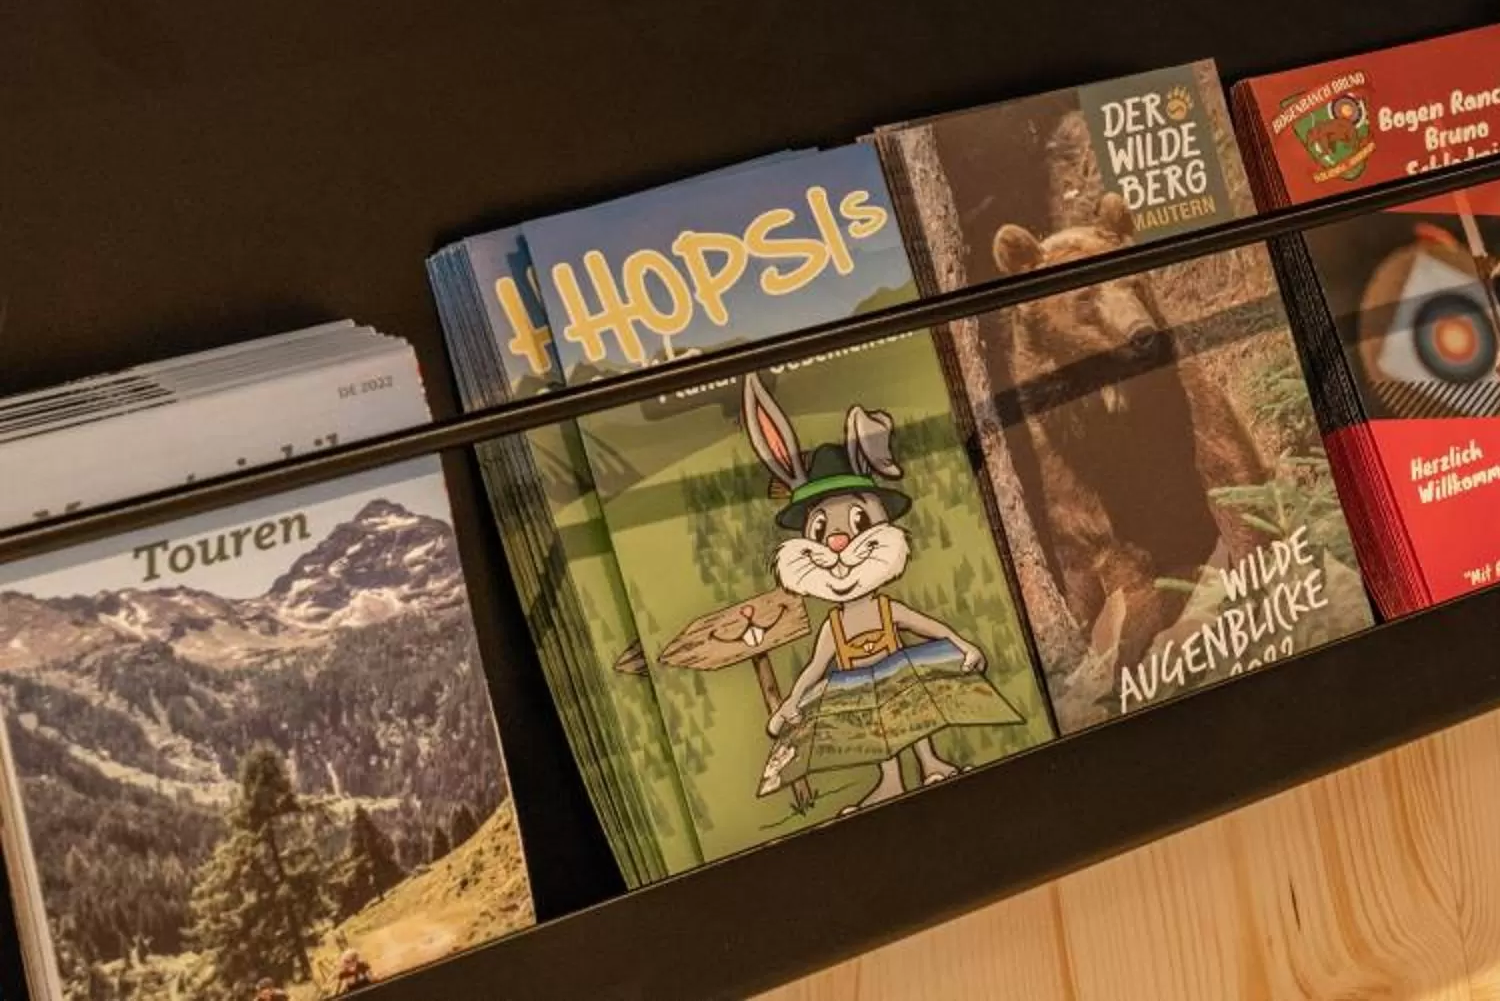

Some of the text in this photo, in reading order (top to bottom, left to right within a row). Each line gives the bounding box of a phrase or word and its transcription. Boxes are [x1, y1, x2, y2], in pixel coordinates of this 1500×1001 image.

[1100, 92, 1166, 138] DER
[1378, 102, 1445, 132] Bogen
[1424, 121, 1490, 152] Bruno
[1107, 121, 1202, 176] WILDE
[1117, 159, 1208, 210] BERG
[1410, 439, 1485, 482] Herzlich
[133, 511, 312, 583] Touren
[1219, 525, 1314, 602] WILDE
[1119, 568, 1329, 714] AUGENBLICKE
